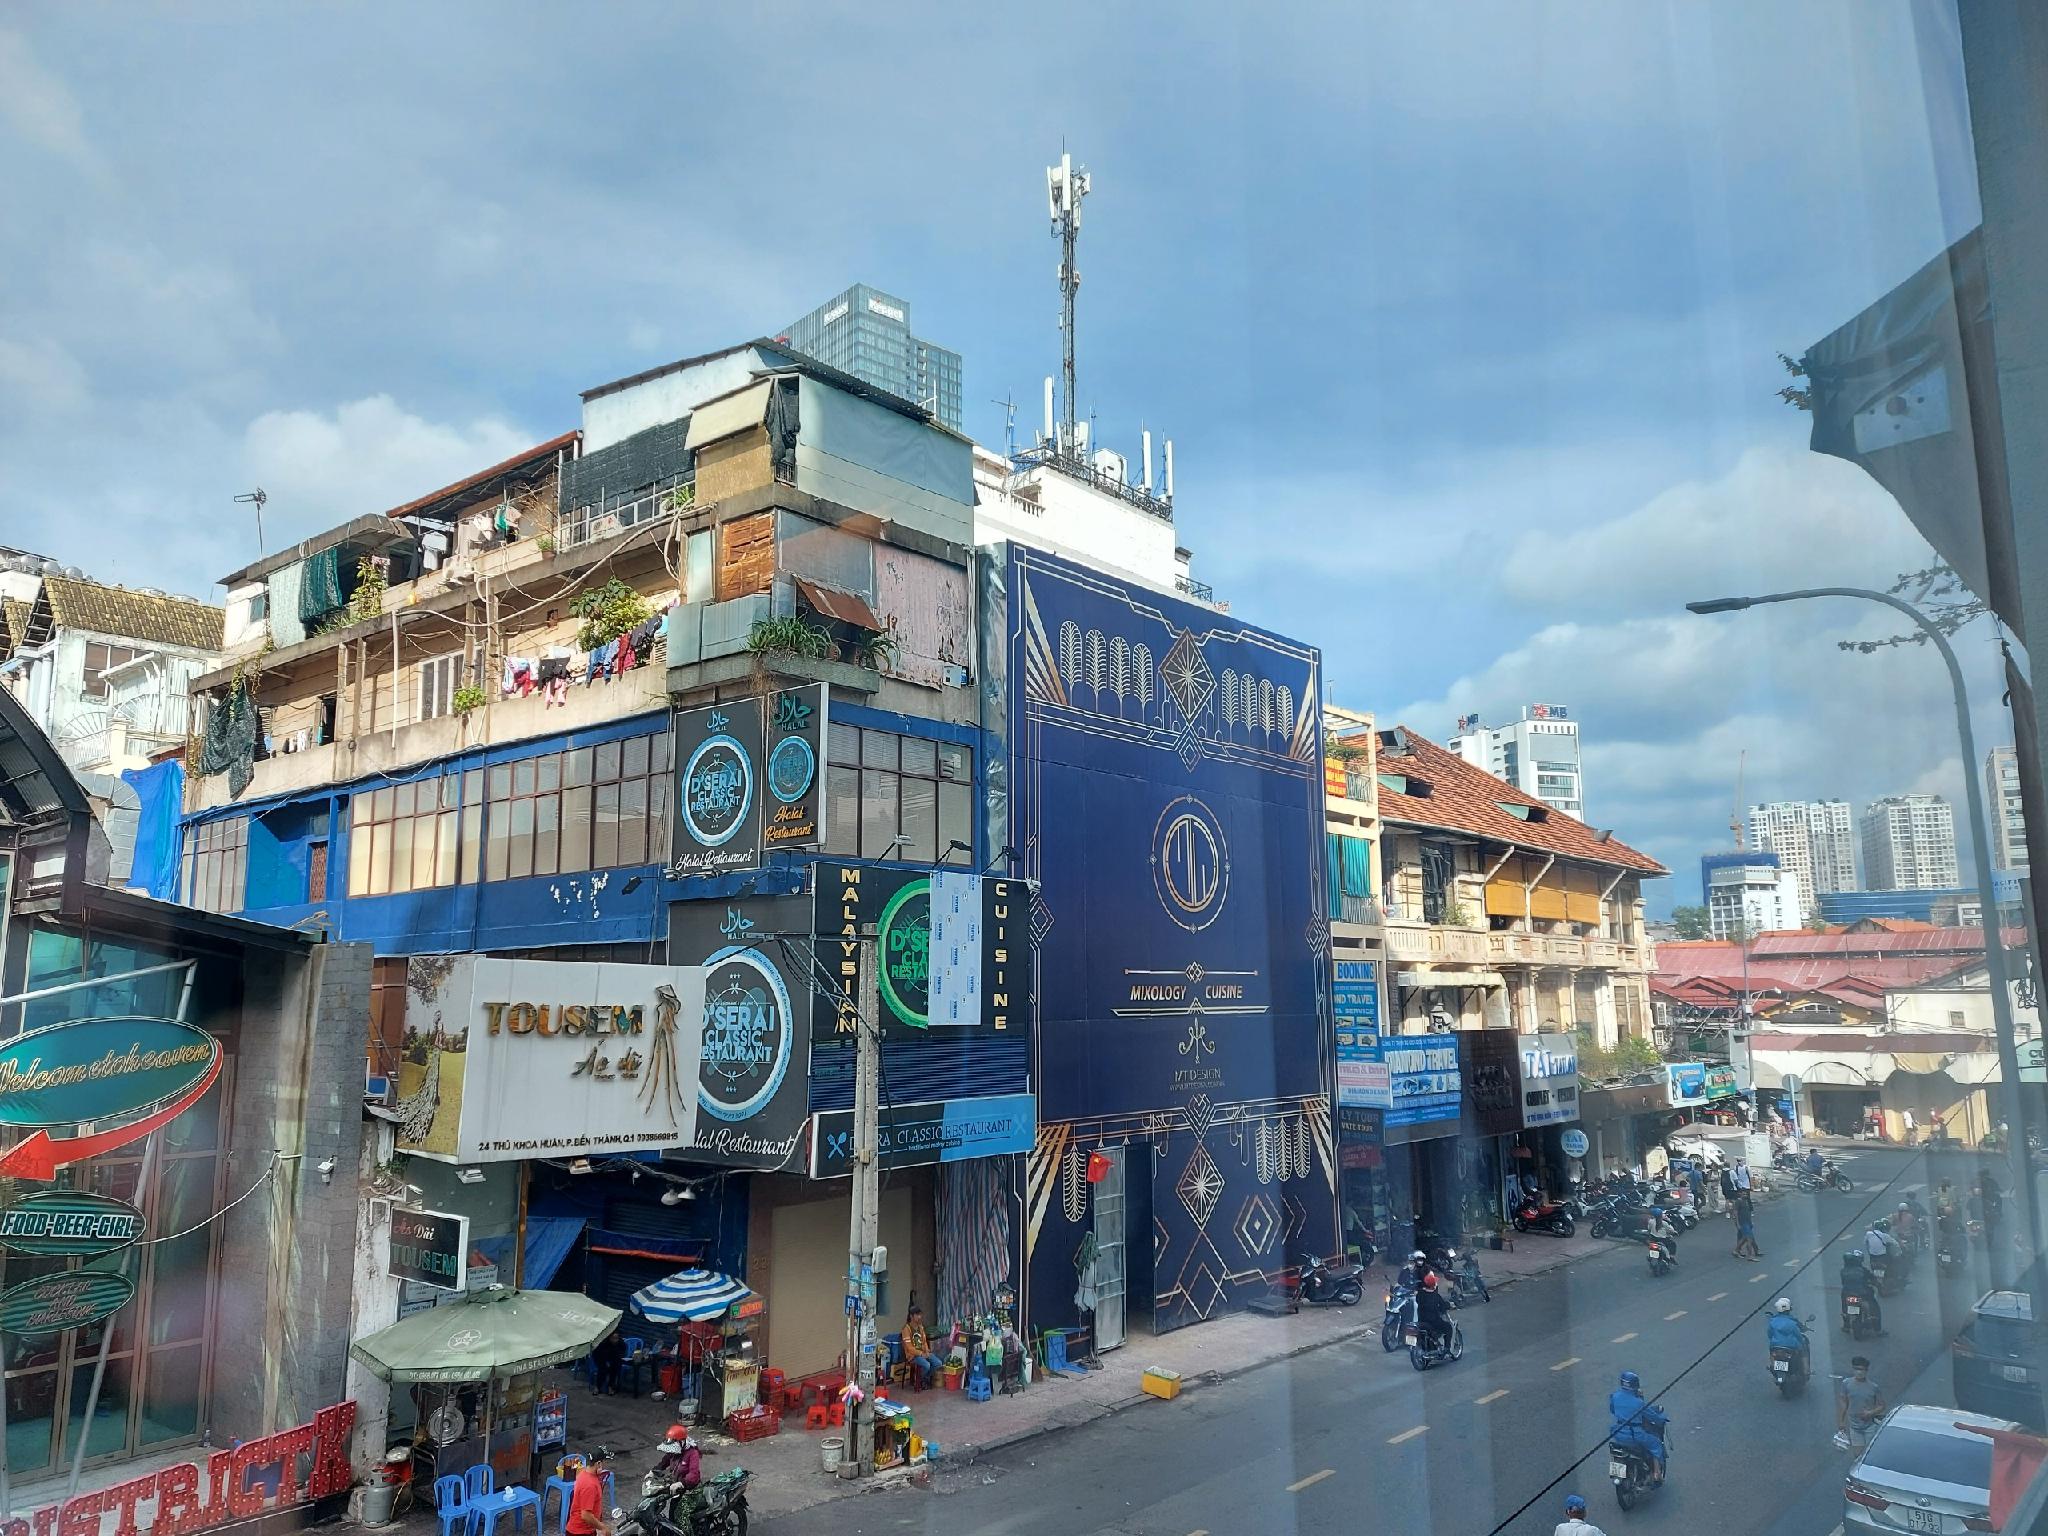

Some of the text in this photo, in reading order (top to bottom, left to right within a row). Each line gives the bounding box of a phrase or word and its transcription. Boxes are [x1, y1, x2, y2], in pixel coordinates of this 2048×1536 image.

[1550, 706, 1568, 719] MB
[781, 720, 806, 731] HALAL
[691, 769, 743, 794] D'SERAI
[690, 795, 742, 813] RESTAURANT
[697, 787, 736, 804] CLASSIC
[773, 805, 805, 823] Halal
[766, 822, 815, 842] Restaurant
[676, 848, 755, 871] Halal Restaurant
[720, 906, 755, 933] حلال
[891, 929, 929, 952] D'SE
[840, 868, 861, 1033] MALAYSIAN
[902, 952, 929, 966] CLA
[993, 883, 1009, 1030] CUISINE
[891, 965, 929, 979] RESTA
[1338, 961, 1375, 980] BOOKING
[1130, 985, 1243, 1001] MIXOLOGY CUISINE
[1347, 994, 1375, 1005] TRAVEL
[483, 1002, 646, 1036] TOUSEM
[705, 1030, 762, 1048] CLASSIC
[700, 1046, 773, 1062] ESTAURANT
[1426, 1048, 1459, 1070] TRAVEL
[897, 1126, 943, 1144] CLASSIC
[945, 1118, 1012, 1139] RESTAURANT
[479, 1142, 490, 1151] 24
[513, 1140, 538, 1150] KHOA
[714, 1128, 793, 1157] Restaurant
[1, 1211, 134, 1238] FOOD-BEER-GIRL
[391, 1243, 457, 1277] TOUSEM
[546, 1350, 574, 1366] COFFEE
